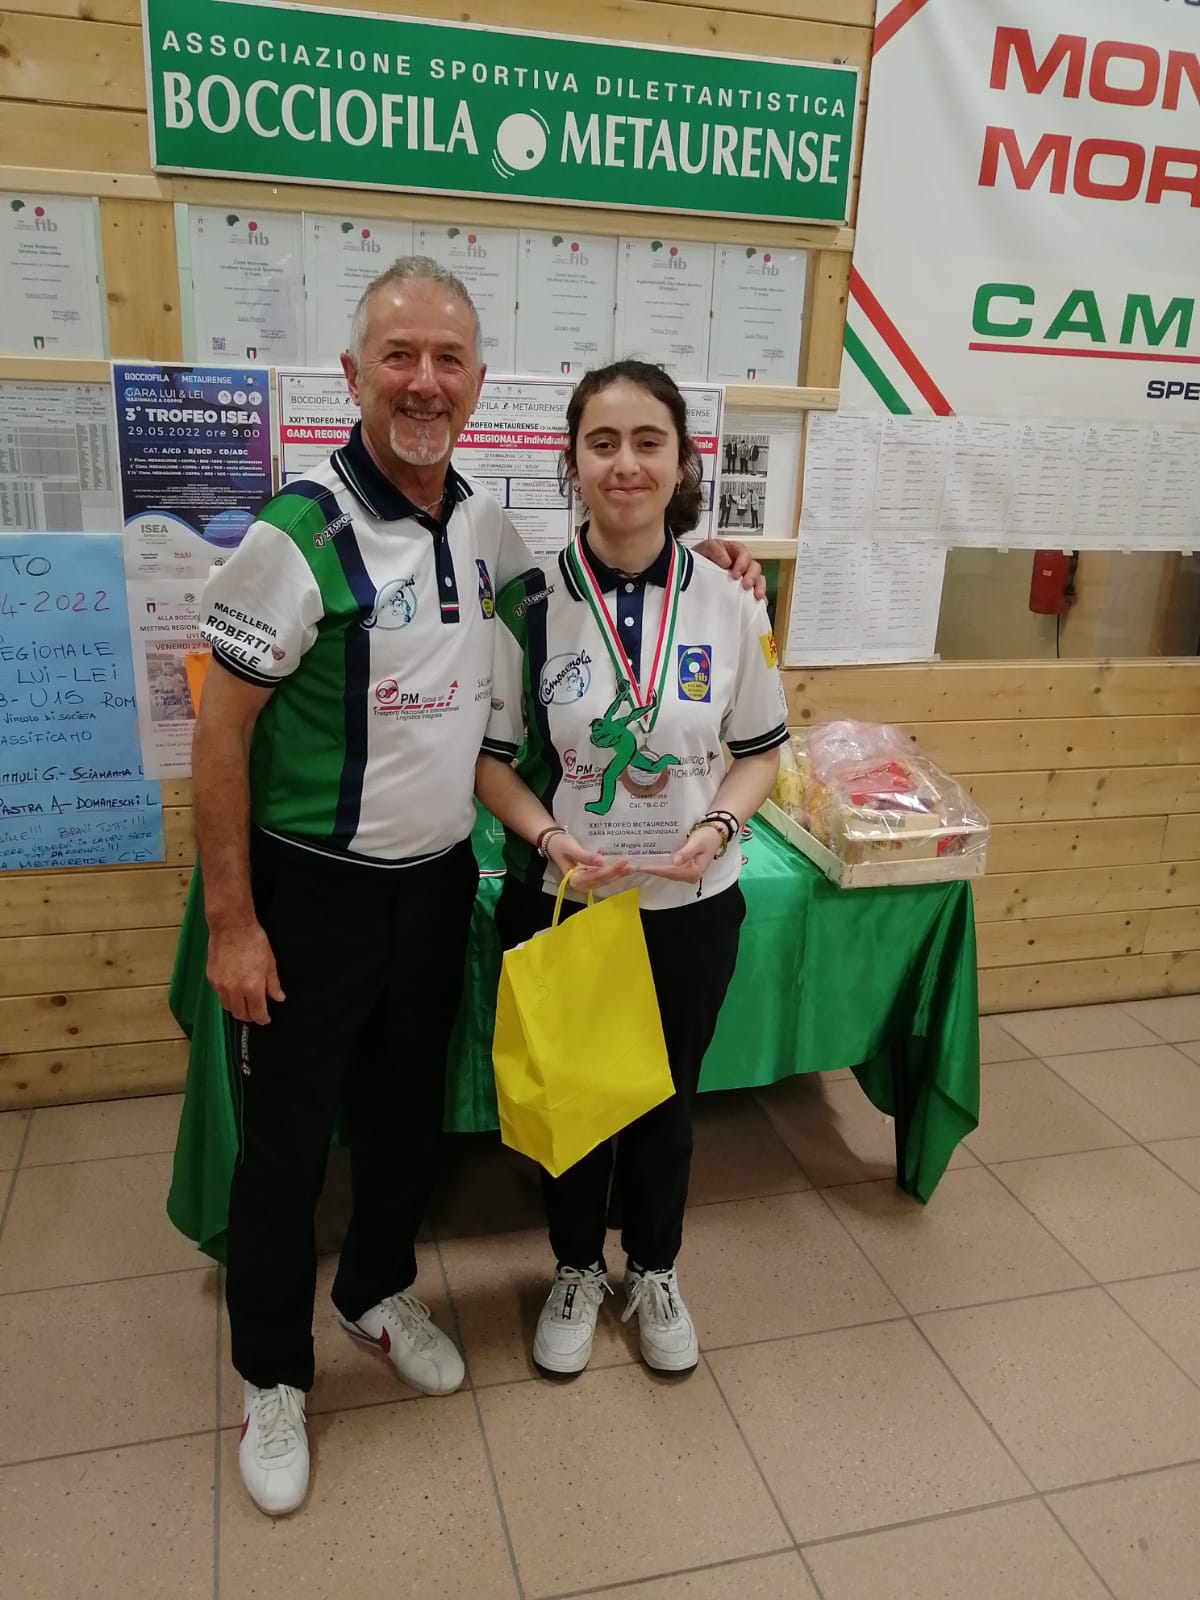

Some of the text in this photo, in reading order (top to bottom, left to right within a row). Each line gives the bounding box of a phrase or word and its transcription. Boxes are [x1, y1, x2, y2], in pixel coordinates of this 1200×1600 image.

[162, 30, 846, 118] ASSOCIAZIONE SPORTIVA DILETTANTISTICA
[163, 71, 841, 184] BOCCIOFILA METAURENSE
[125, 373, 232, 384] BOCCIOFILA METAURENSE
[125, 388, 157, 398] GARA
[159, 389, 176, 399] LUI
[188, 390, 204, 400] LEI
[291, 396, 340, 405] BOCCIOFILA
[512, 403, 565, 412] METAURENSE
[125, 406, 262, 424] 3° TROFEO ISEA
[494, 422, 539, 430] METAURENSE
[128, 426, 260, 438] 29.05.2022 ore 9.00
[286, 429, 314, 439] GARA
[474, 434, 523, 444] REGIONALE
[219, 448, 248, 456] CD/ABC
[141, 524, 169, 533] ISEA
[214, 602, 277, 638] MACELLERIA
[206, 615, 271, 653] ROBERTI
[200, 631, 261, 669] SAMUELE
[694, 672, 707, 682] fib
[400, 693, 419, 704] PM
[576, 764, 593, 774] PM
[633, 820, 679, 828] METAURENSE
